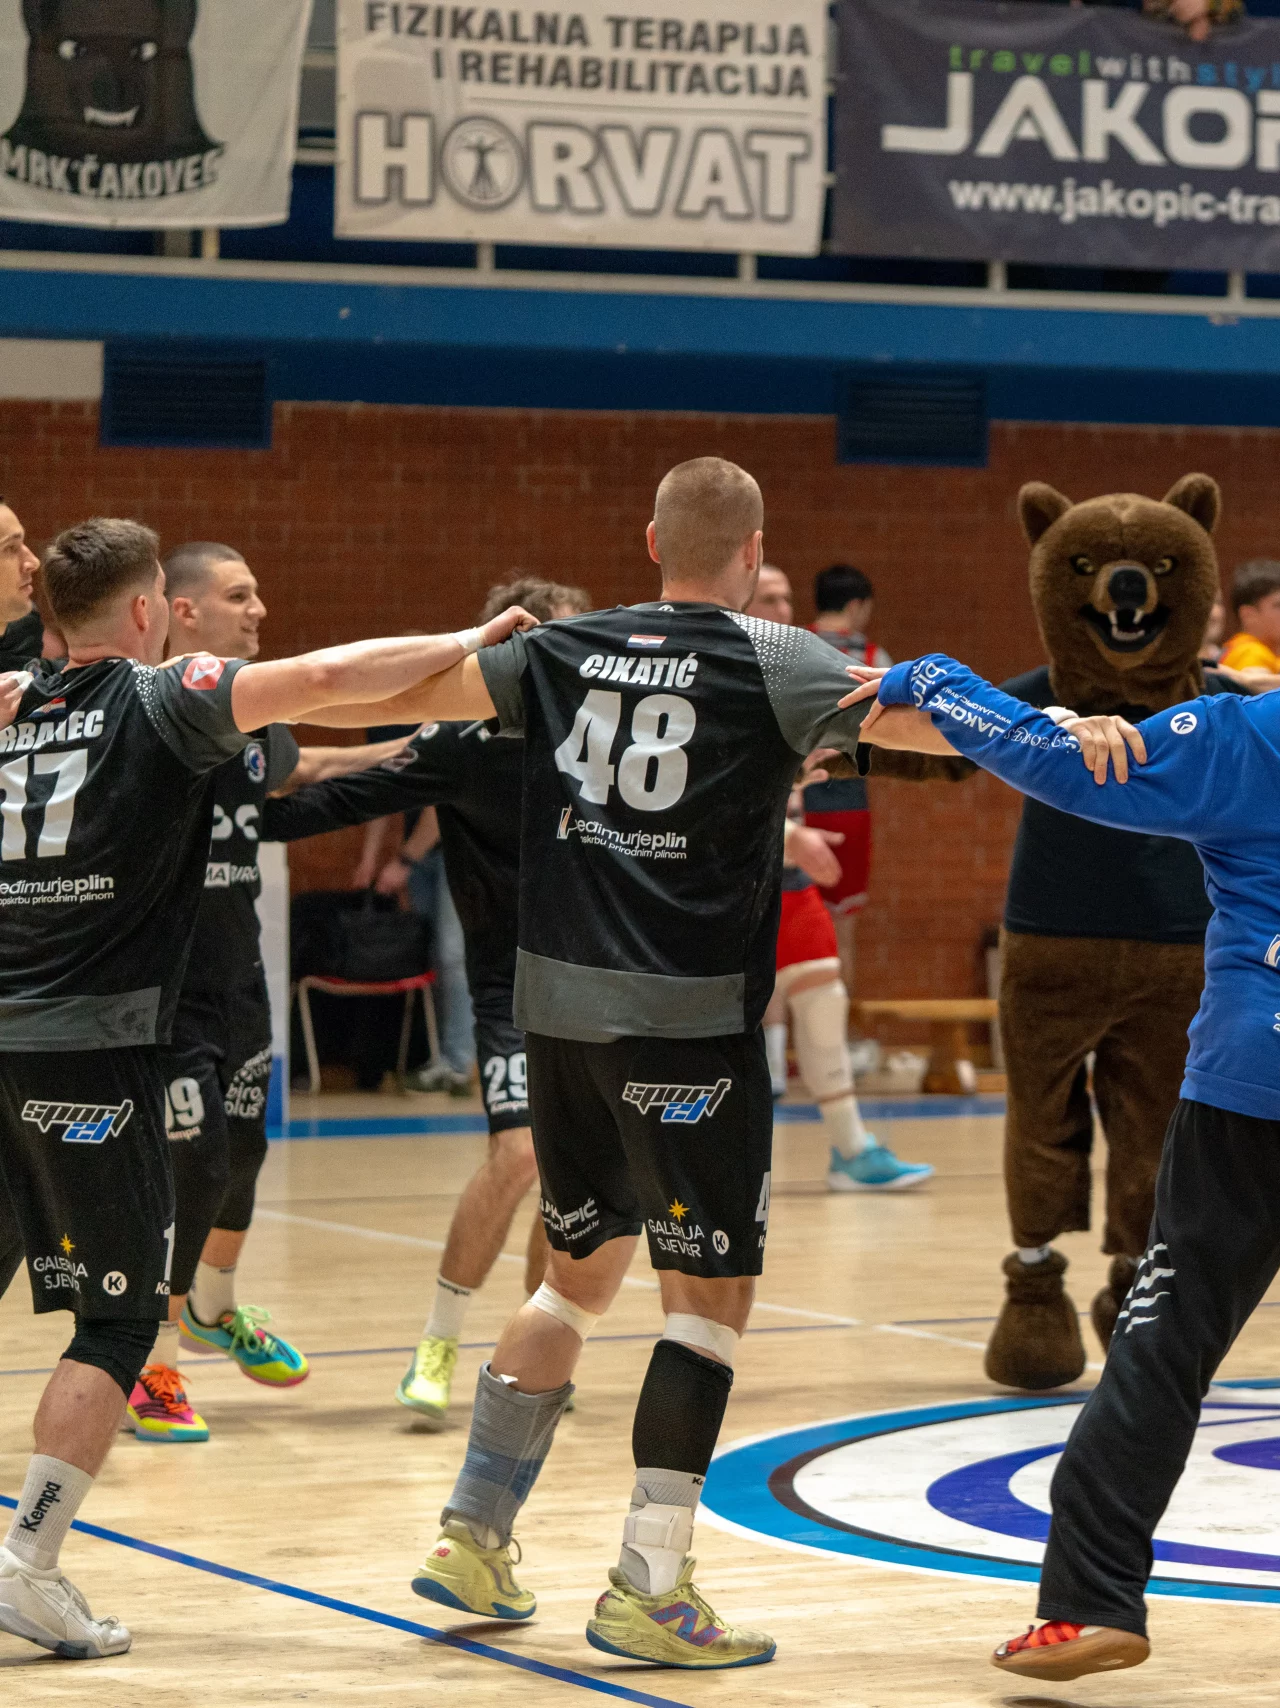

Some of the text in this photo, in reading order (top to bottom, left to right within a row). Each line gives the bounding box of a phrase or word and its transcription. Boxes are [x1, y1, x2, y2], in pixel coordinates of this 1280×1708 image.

[366, 2, 812, 57] FIZIKALNA TERAPIJA
[432, 51, 812, 99] I REHABILITACIJA
[0, 137, 72, 192] MRK
[354, 112, 812, 221] HORVAT
[579, 653, 698, 689] CIKATIĆ
[554, 689, 697, 812] 48
[0, 748, 89, 861] 17
[577, 818, 687, 850] eđimurjeplin
[609, 841, 653, 859] prirodnim
[654, 848, 687, 860] plinom
[79, 890, 114, 901] plinom
[484, 1053, 528, 1105] 29
[19, 1480, 62, 1533] Kempa
